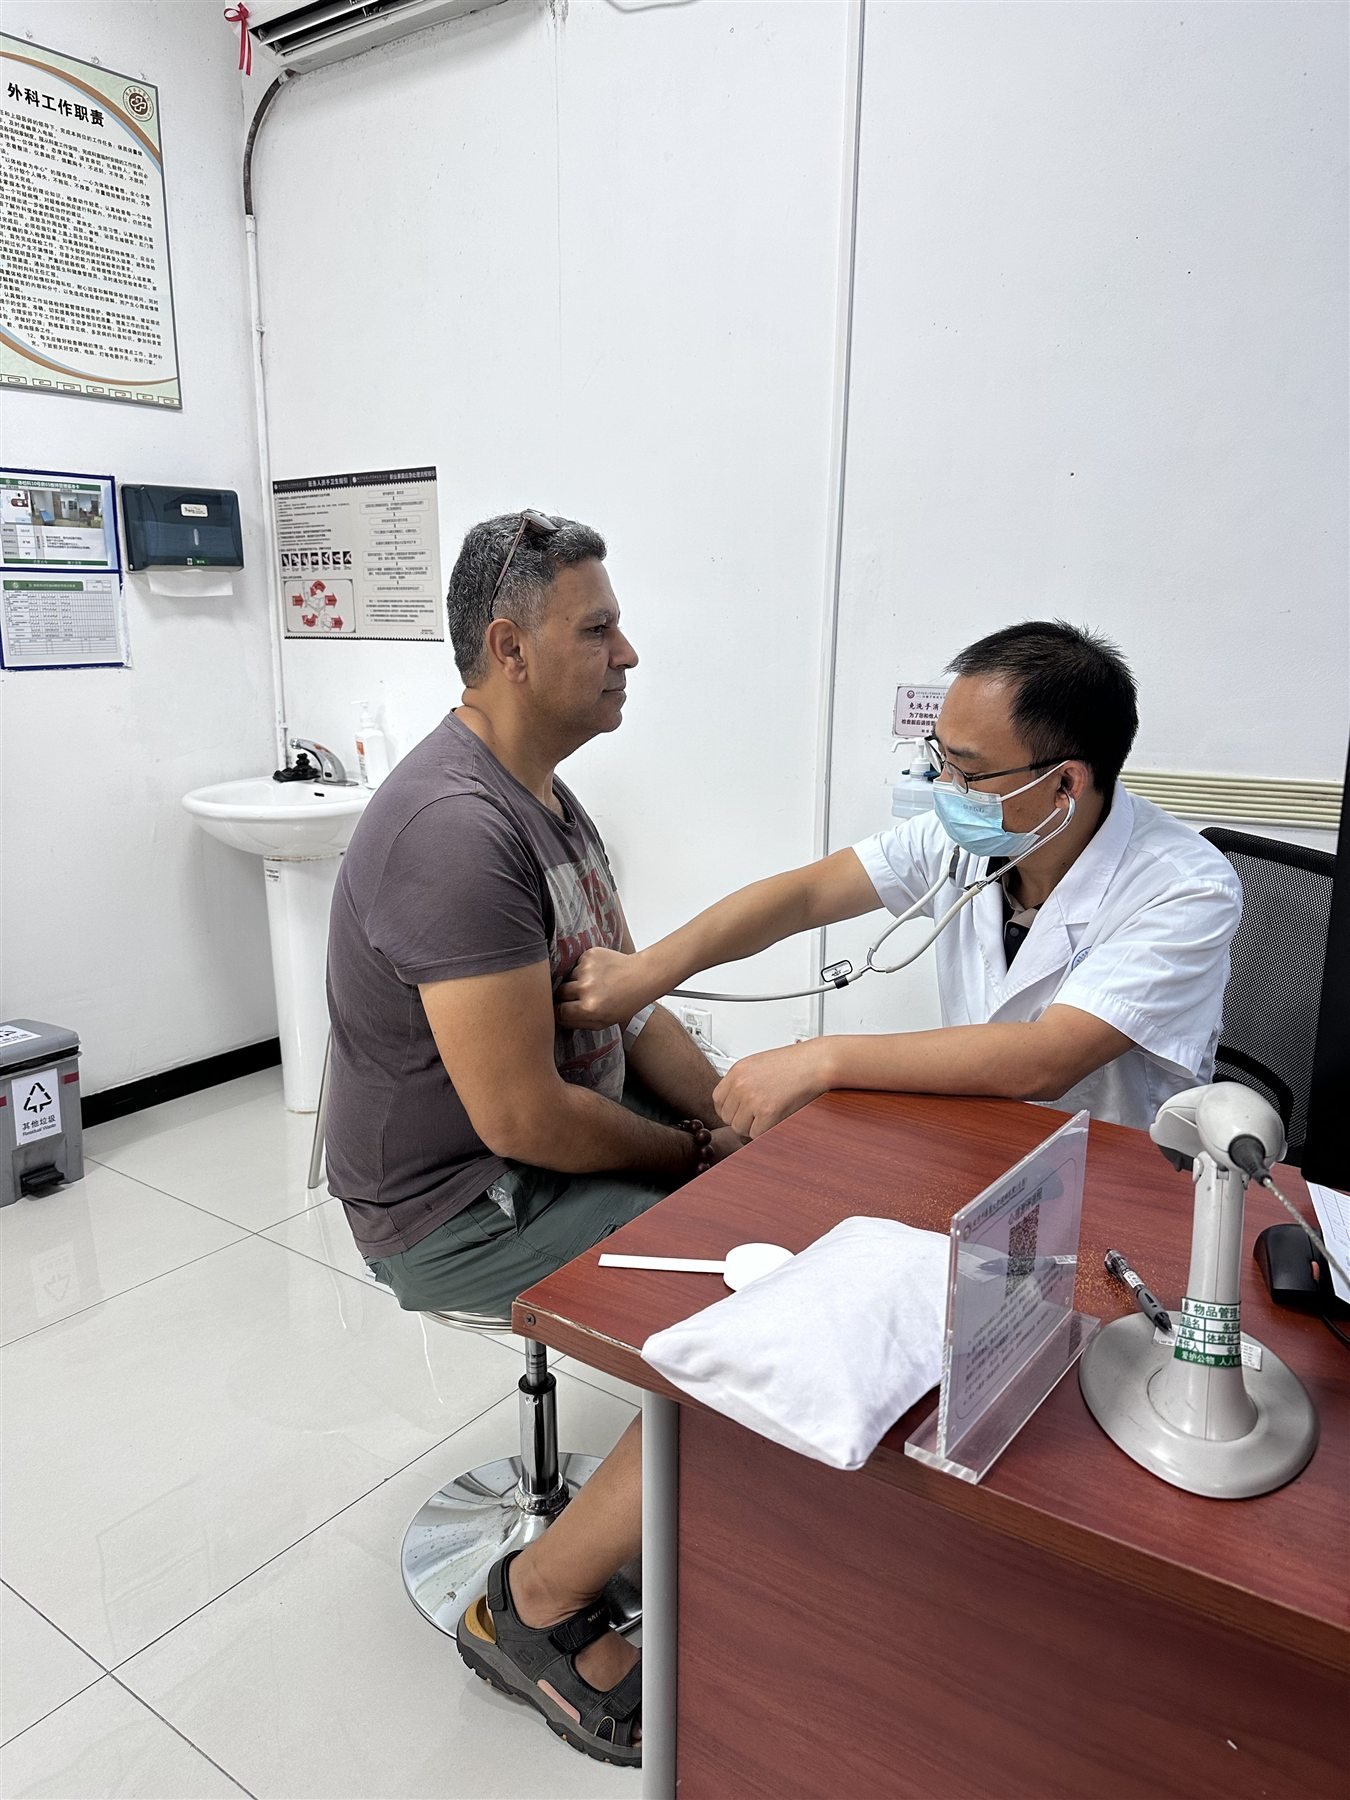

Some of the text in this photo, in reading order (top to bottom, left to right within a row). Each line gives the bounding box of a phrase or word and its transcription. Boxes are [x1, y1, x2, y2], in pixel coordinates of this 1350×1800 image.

[6, 80, 104, 129] 外科工作职责
[23, 1115, 56, 1130] 其他垃圾
[1194, 1303, 1240, 1319] 物品管理
[1182, 1351, 1215, 1365] 爱护公物
